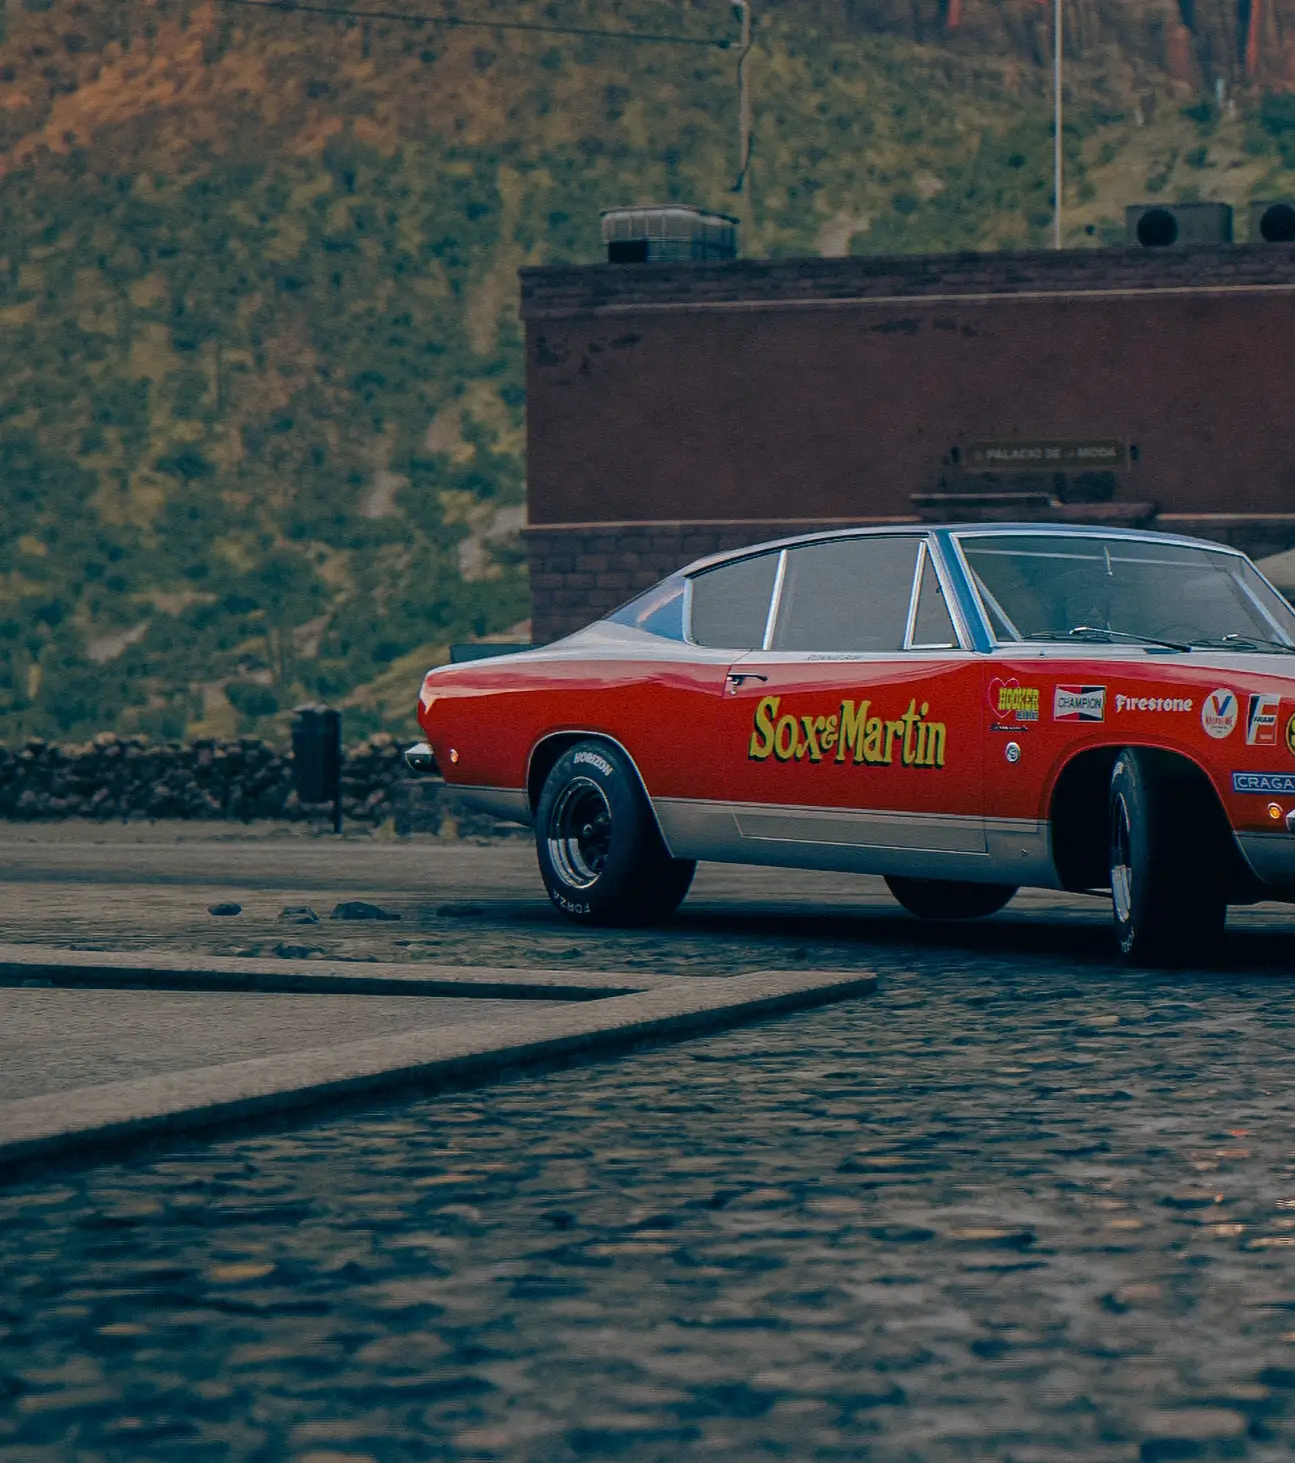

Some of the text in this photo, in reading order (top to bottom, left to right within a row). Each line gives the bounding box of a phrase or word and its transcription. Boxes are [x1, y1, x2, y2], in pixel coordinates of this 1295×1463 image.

[998, 687, 1039, 711] HOOKER
[1057, 696, 1102, 709] CHAMPION
[1115, 694, 1193, 713] Firestone
[573, 751, 614, 776] HORIZON
